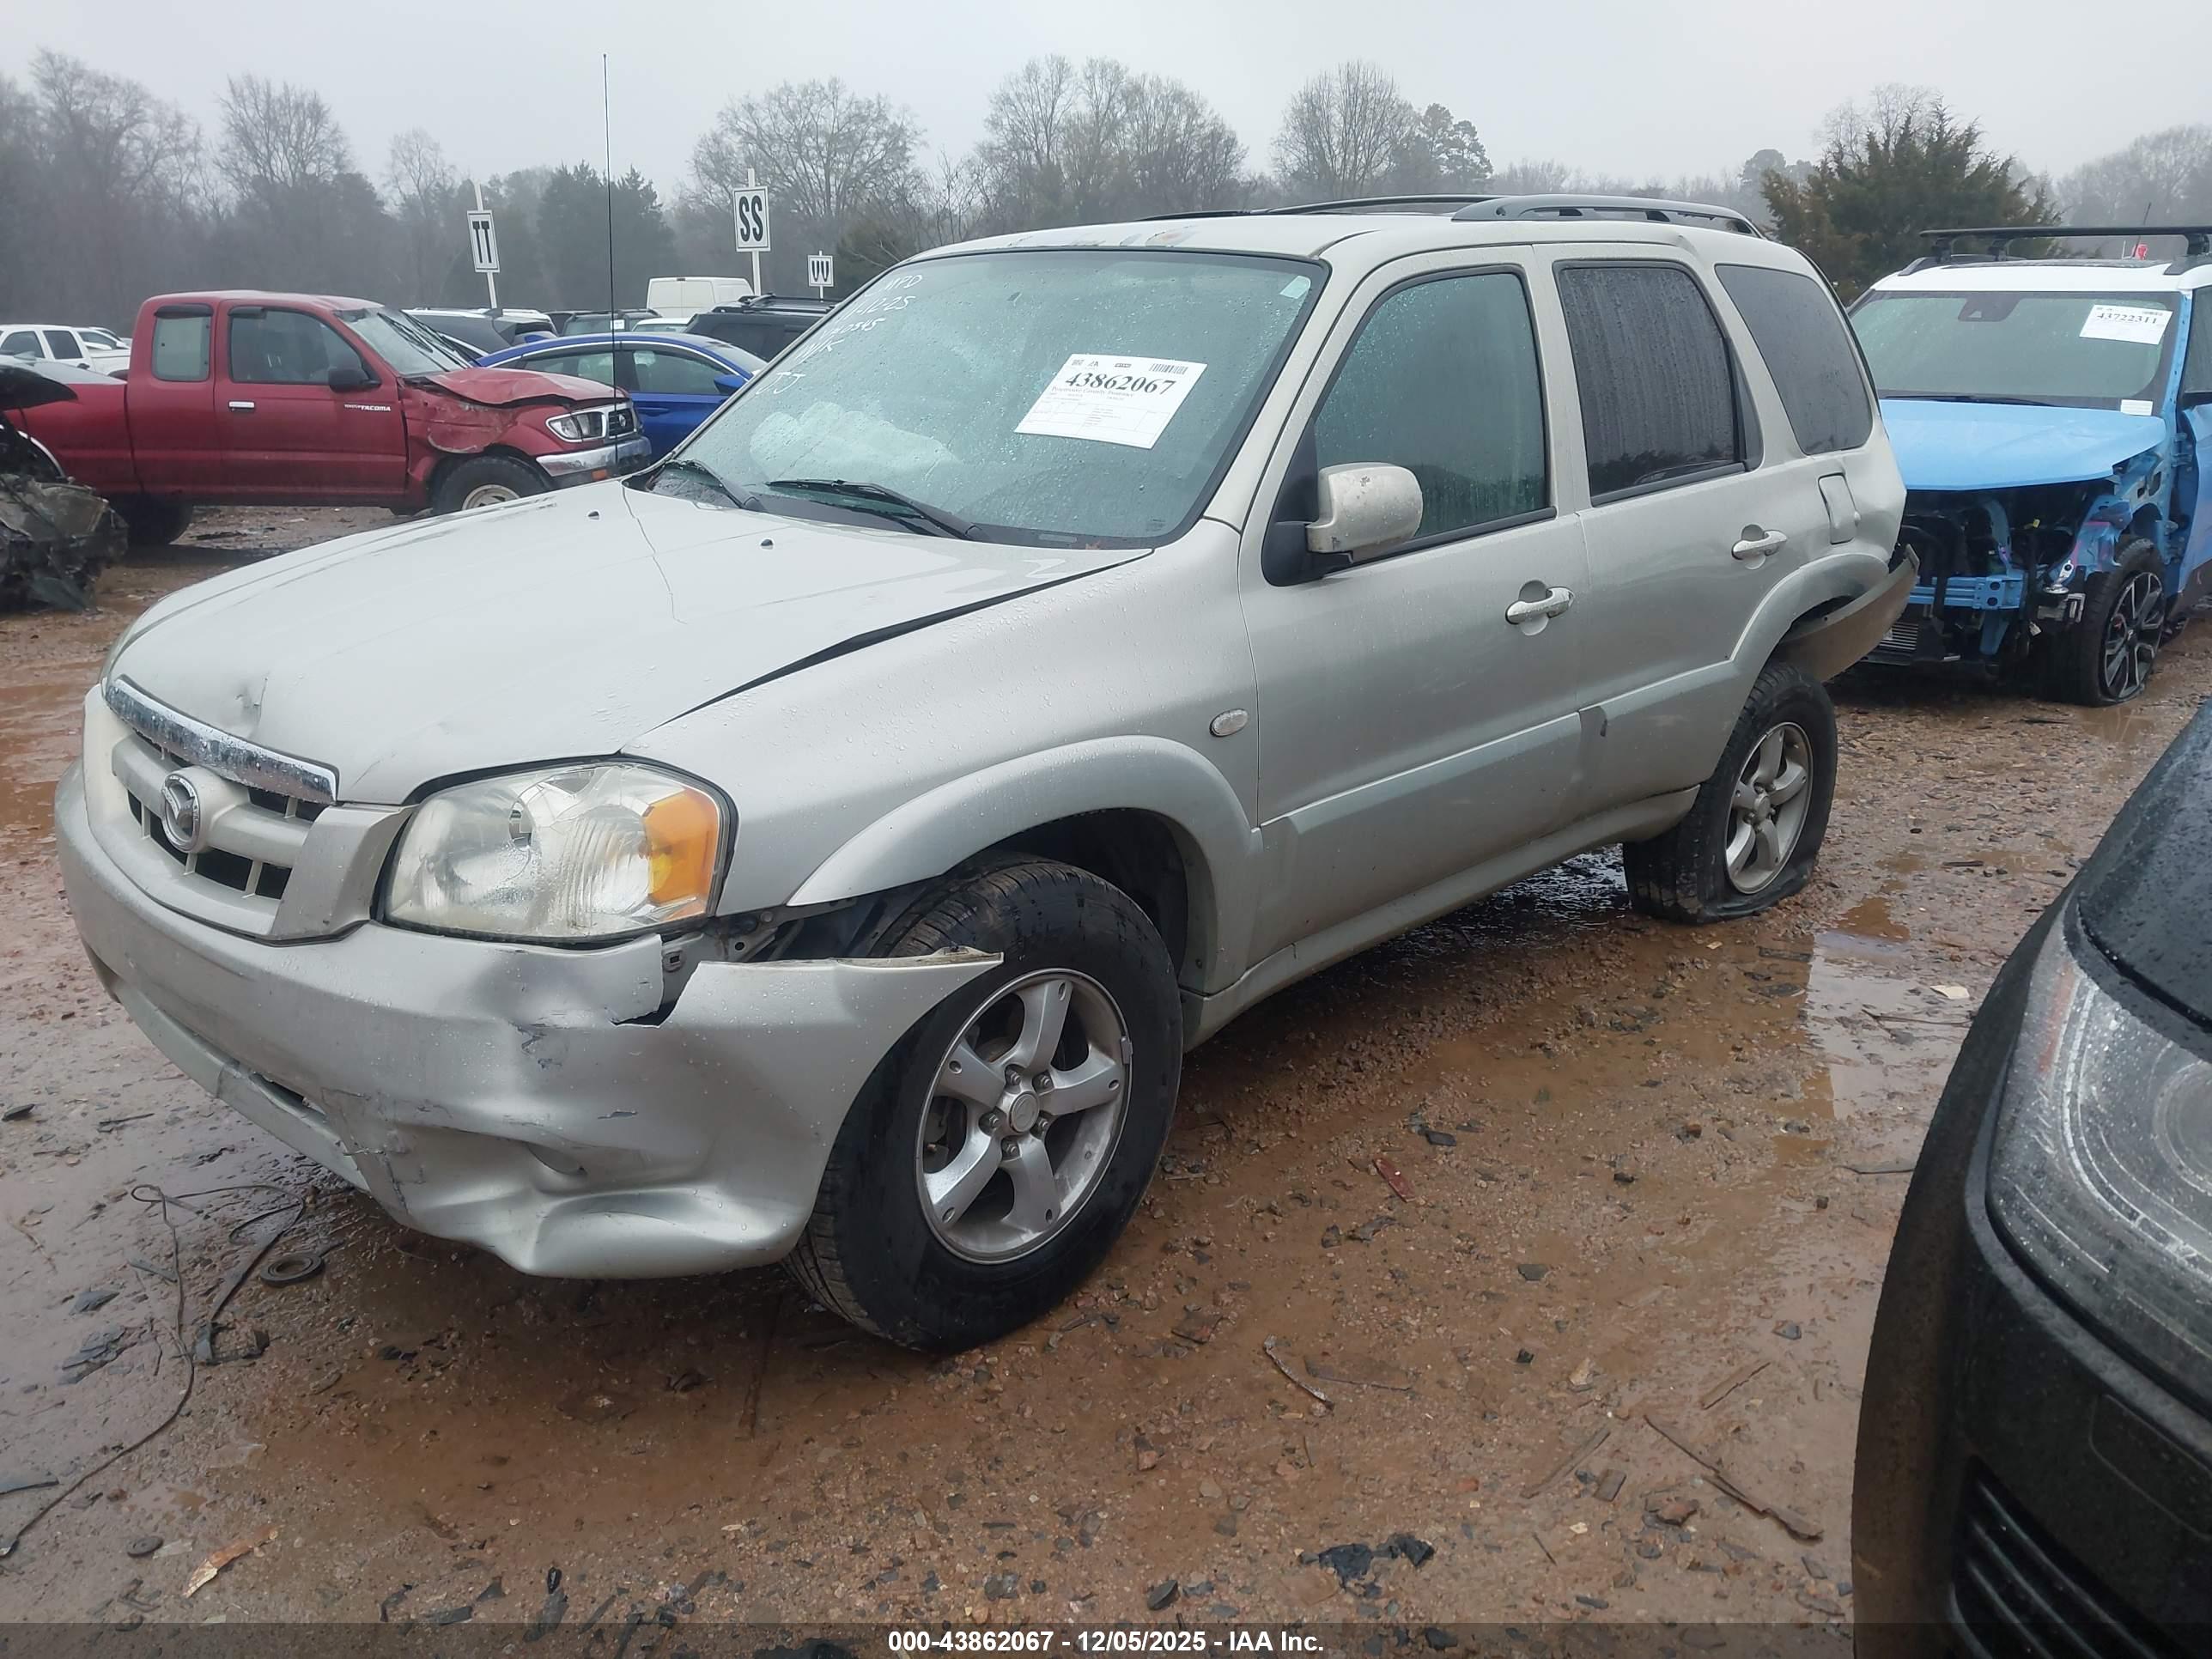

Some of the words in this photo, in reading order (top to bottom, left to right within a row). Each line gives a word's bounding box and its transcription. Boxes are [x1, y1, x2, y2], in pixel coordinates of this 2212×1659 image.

[738, 195, 763, 242] SS
[472, 220, 493, 264] TT
[2097, 313, 2157, 325] 43722311
[1065, 372, 1177, 396] 43862067
